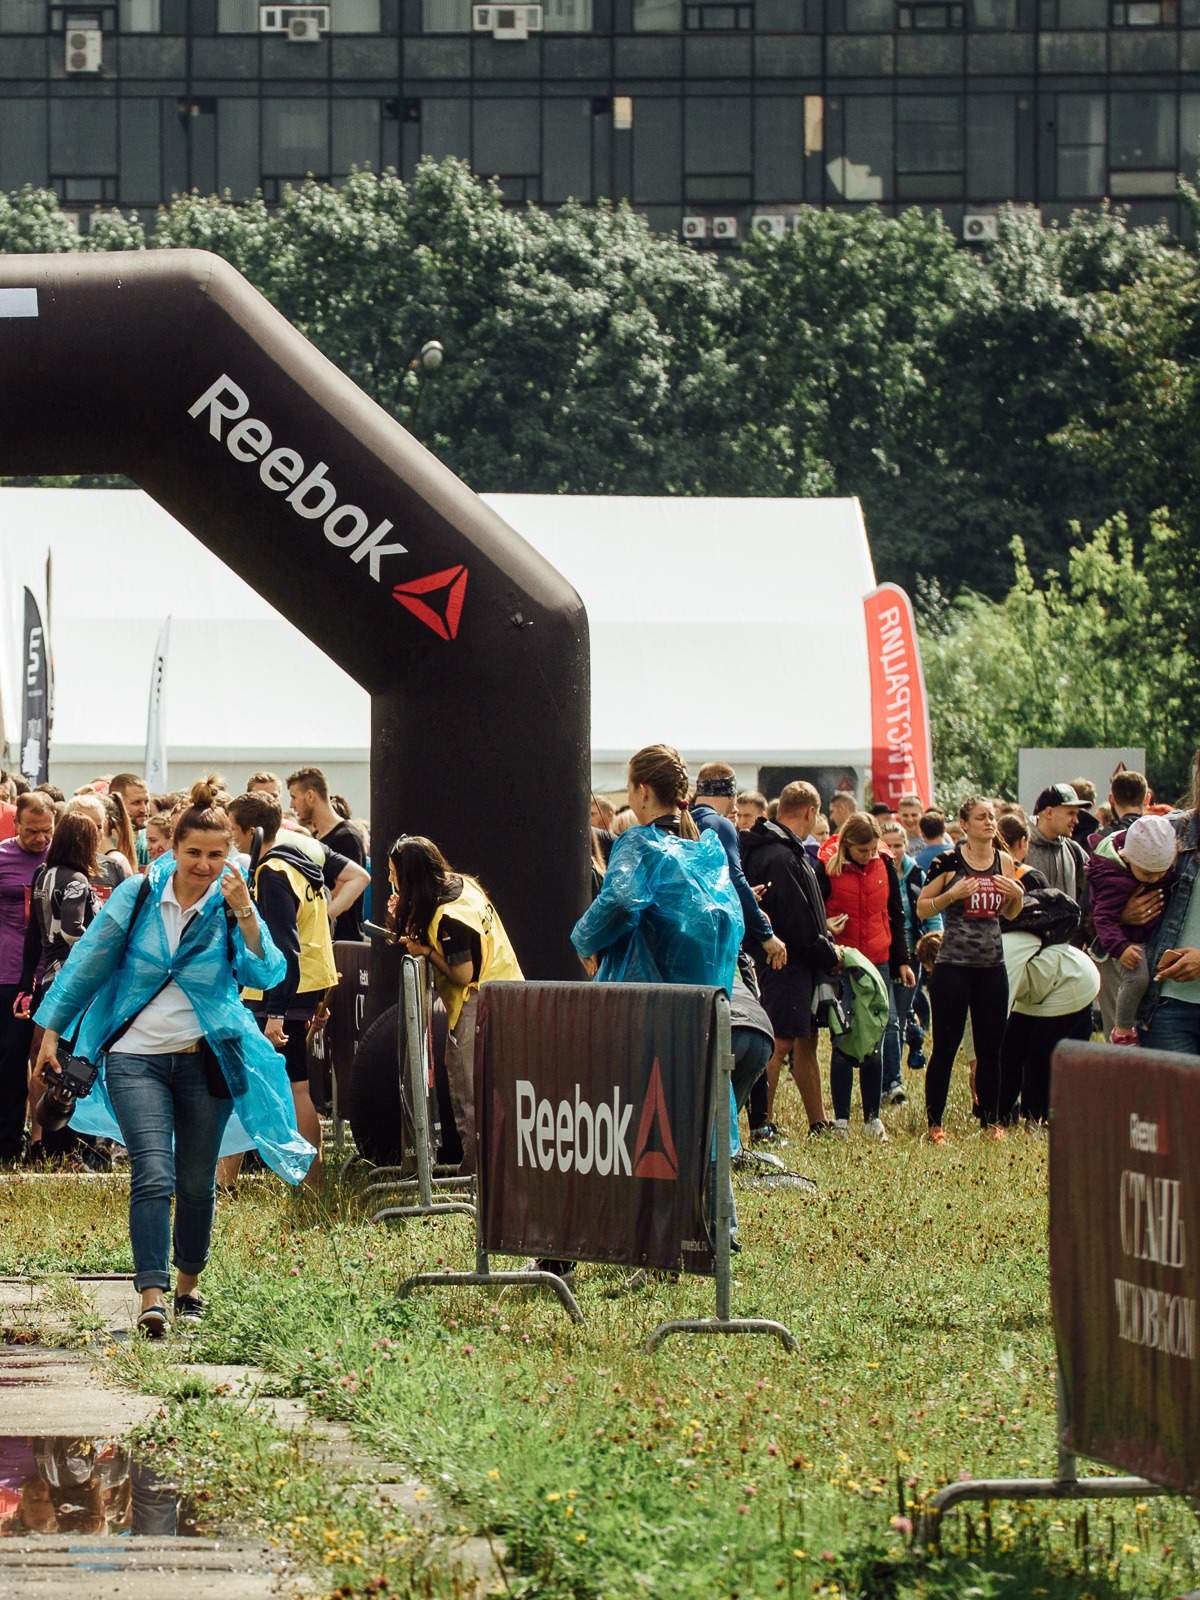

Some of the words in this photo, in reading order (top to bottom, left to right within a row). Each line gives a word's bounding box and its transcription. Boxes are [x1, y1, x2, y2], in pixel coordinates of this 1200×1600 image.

[187, 373, 409, 582] Reebok
[971, 892, 1002, 910] R119
[515, 1080, 634, 1177] Reebok
